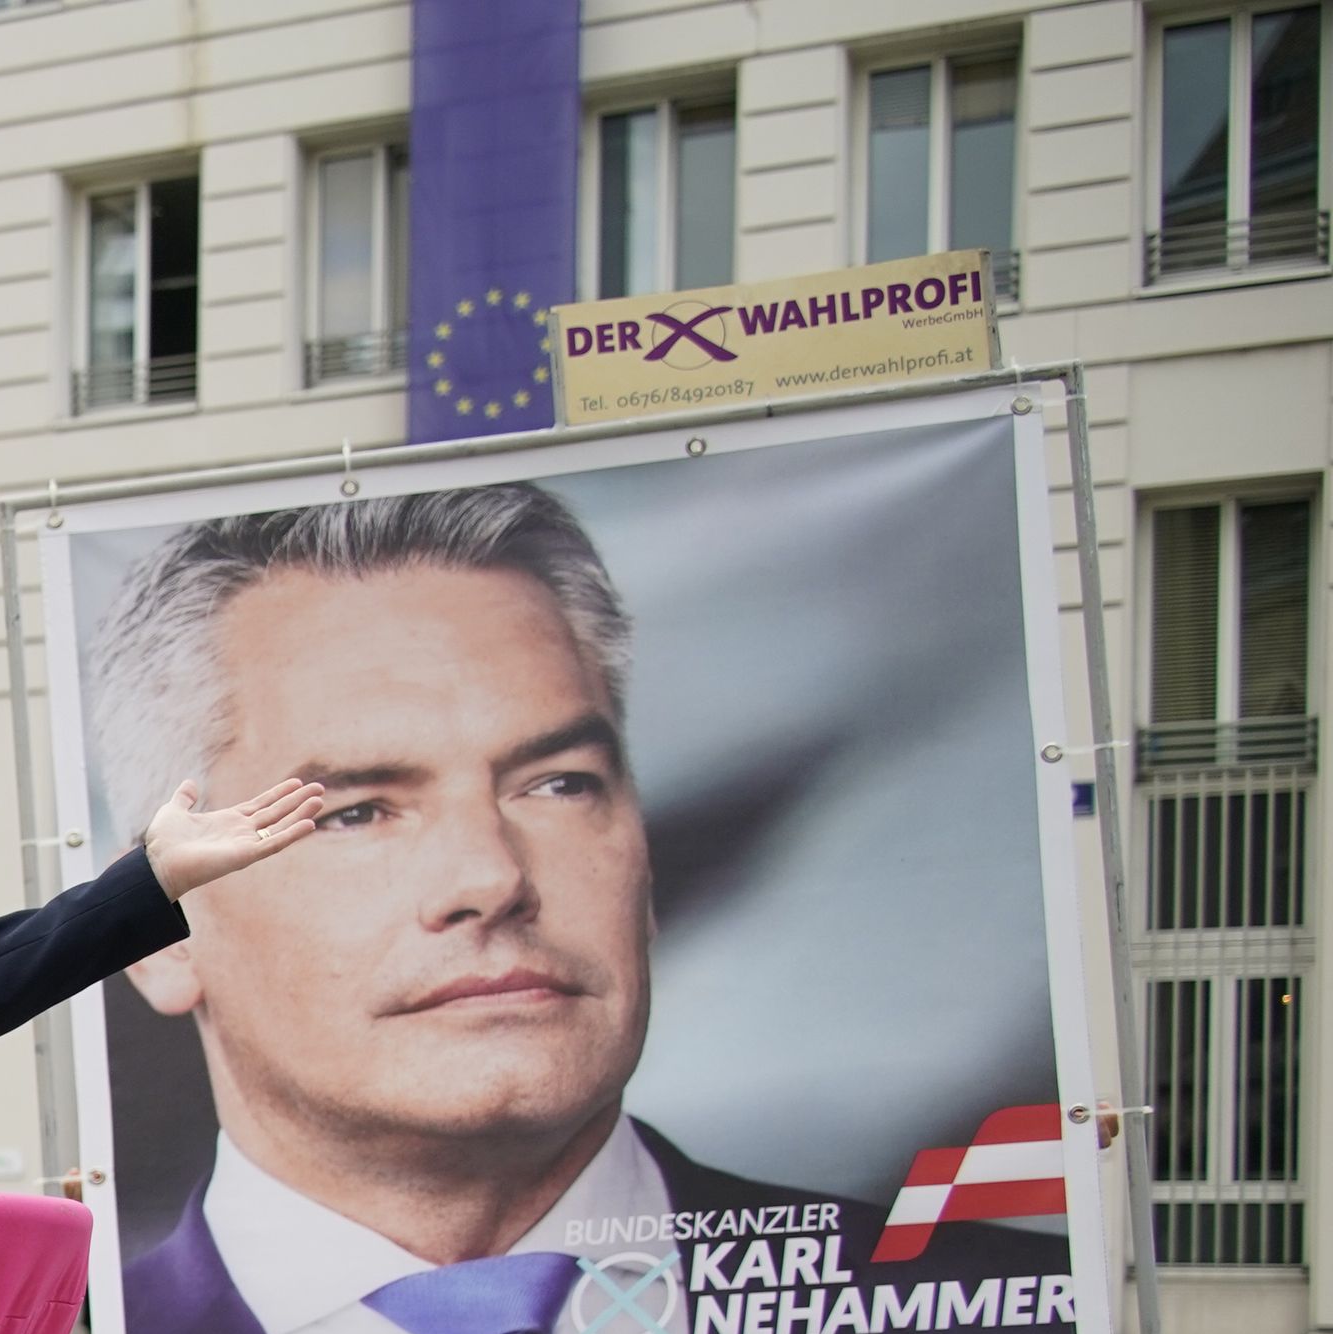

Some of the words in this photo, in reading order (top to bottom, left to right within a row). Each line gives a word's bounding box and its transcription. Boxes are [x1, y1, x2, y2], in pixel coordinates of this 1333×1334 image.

[566, 321, 642, 357] DER
[739, 271, 983, 336] WAHLPROFI
[901, 309, 984, 330] WerbeGmbH
[581, 396, 608, 412] Tel.
[617, 380, 754, 409] 0676/84920187
[775, 347, 973, 387] www.derwahlprofi.at
[564, 1202, 840, 1247] BUNDESKANZLER
[688, 1234, 853, 1293] KARL
